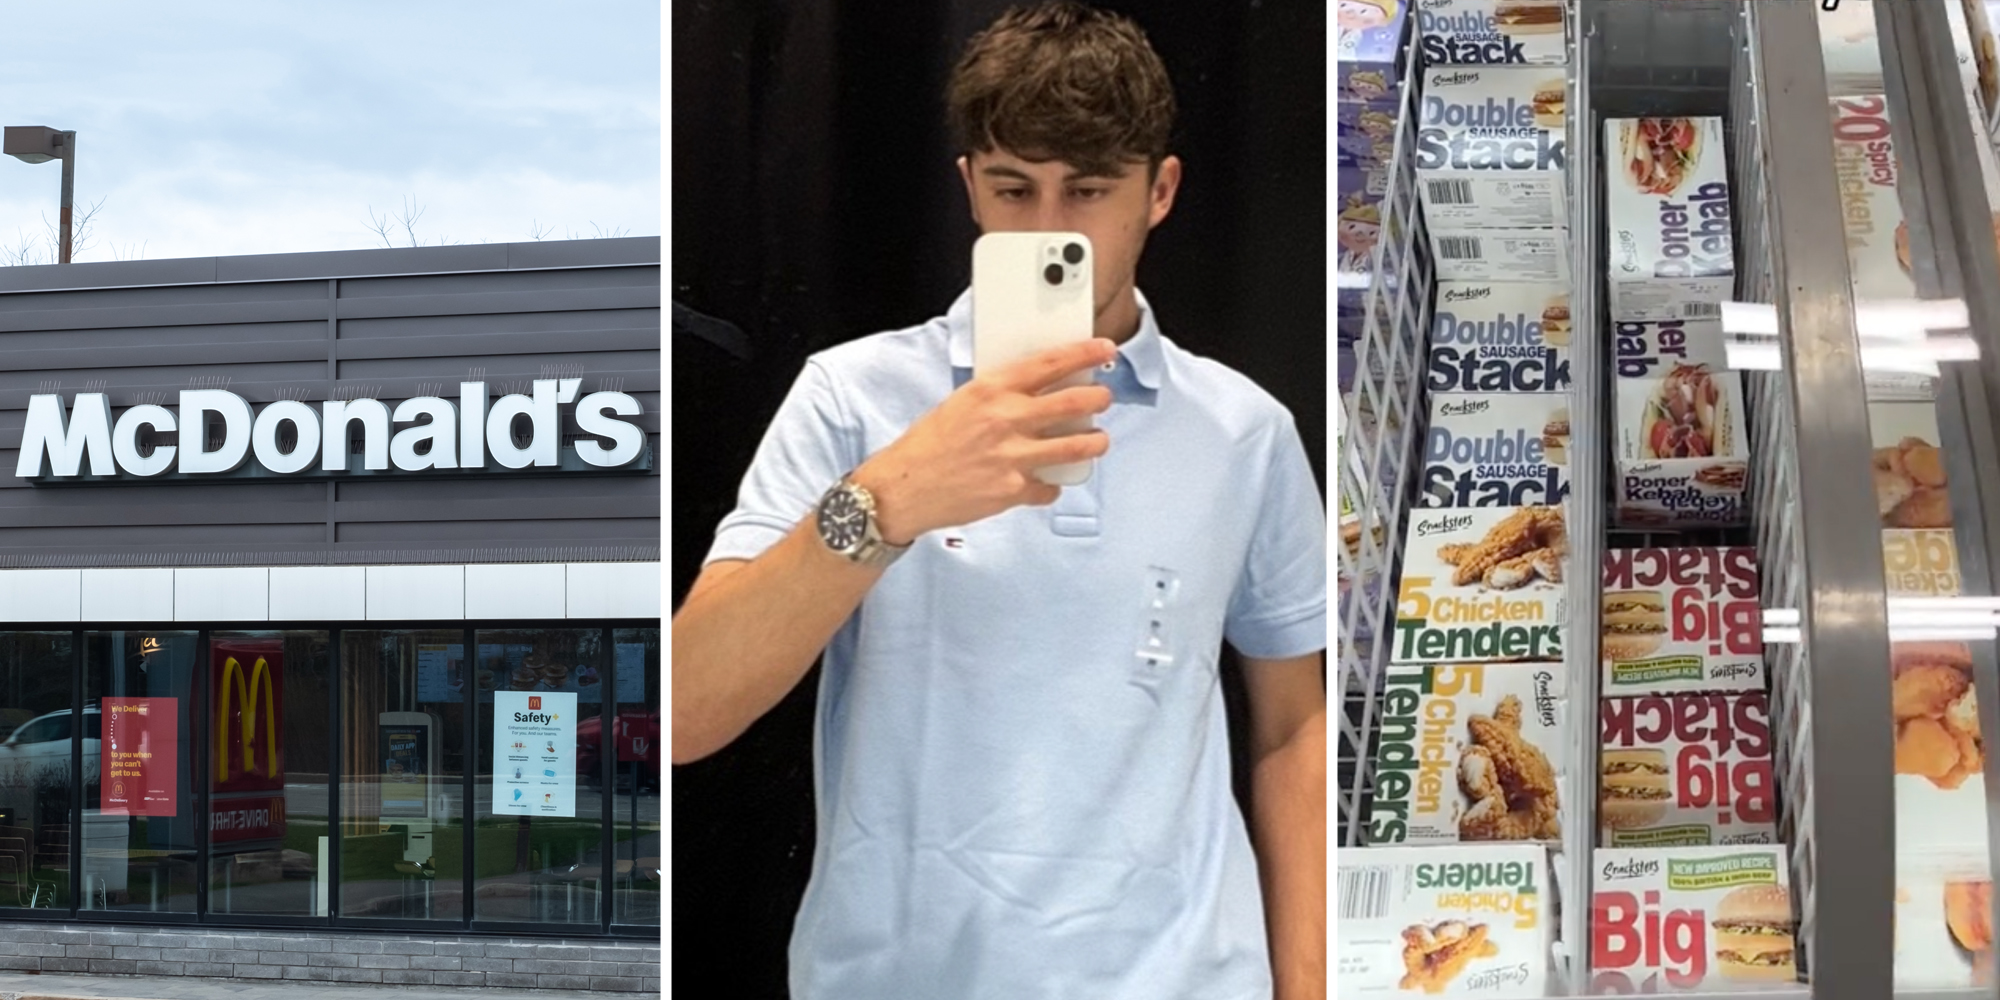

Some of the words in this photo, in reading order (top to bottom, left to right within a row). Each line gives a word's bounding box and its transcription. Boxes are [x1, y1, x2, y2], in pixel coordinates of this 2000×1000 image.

[1421, 10, 1498, 33] Double
[1455, 33, 1503, 42] SAUSAGE
[1424, 34, 1527, 64] Stack
[1425, 95, 1535, 127] Double
[1416, 128, 1565, 170] Stack
[1469, 128, 1538, 139] SAUSAGE
[1865, 141, 1896, 187] Spicy
[1654, 200, 1691, 277] Doner
[1688, 182, 1734, 277] Kebab
[1432, 312, 1544, 345] Double
[1479, 346, 1546, 358] SAUSAGE
[1616, 321, 1658, 378] bab
[1428, 347, 1571, 391] Stack
[15, 377, 647, 477] McDonald's
[1427, 426, 1545, 464] Double
[1419, 465, 1571, 507] Stack
[1475, 464, 1547, 478] SAUSAGE
[1625, 476, 1690, 488] Doner
[1626, 486, 1702, 501] Kebab
[1603, 547, 1760, 598] Stack
[1397, 576, 1435, 620] 5
[1433, 595, 1544, 623] Chicken
[1396, 619, 1562, 660] Tenders
[1671, 587, 1765, 655] Big
[1434, 665, 1484, 697] 5
[111, 705, 122, 713] We
[123, 705, 148, 713] Deliver
[1602, 689, 1771, 757] Stack
[111, 760, 124, 768] you
[124, 759, 142, 767] can't
[119, 752, 132, 760] you
[1370, 666, 1434, 843] Tenders
[1416, 701, 1457, 814] Chicken
[110, 769, 122, 778] get
[123, 769, 131, 777] to
[1677, 745, 1776, 825] Big
[1416, 861, 1538, 894] Tenders
[1672, 863, 1694, 875] NEW
[1741, 856, 1773, 870] RECIPE
[1437, 892, 1513, 912] Chicken
[1513, 893, 1539, 930] 5
[1593, 889, 1708, 989] Big
